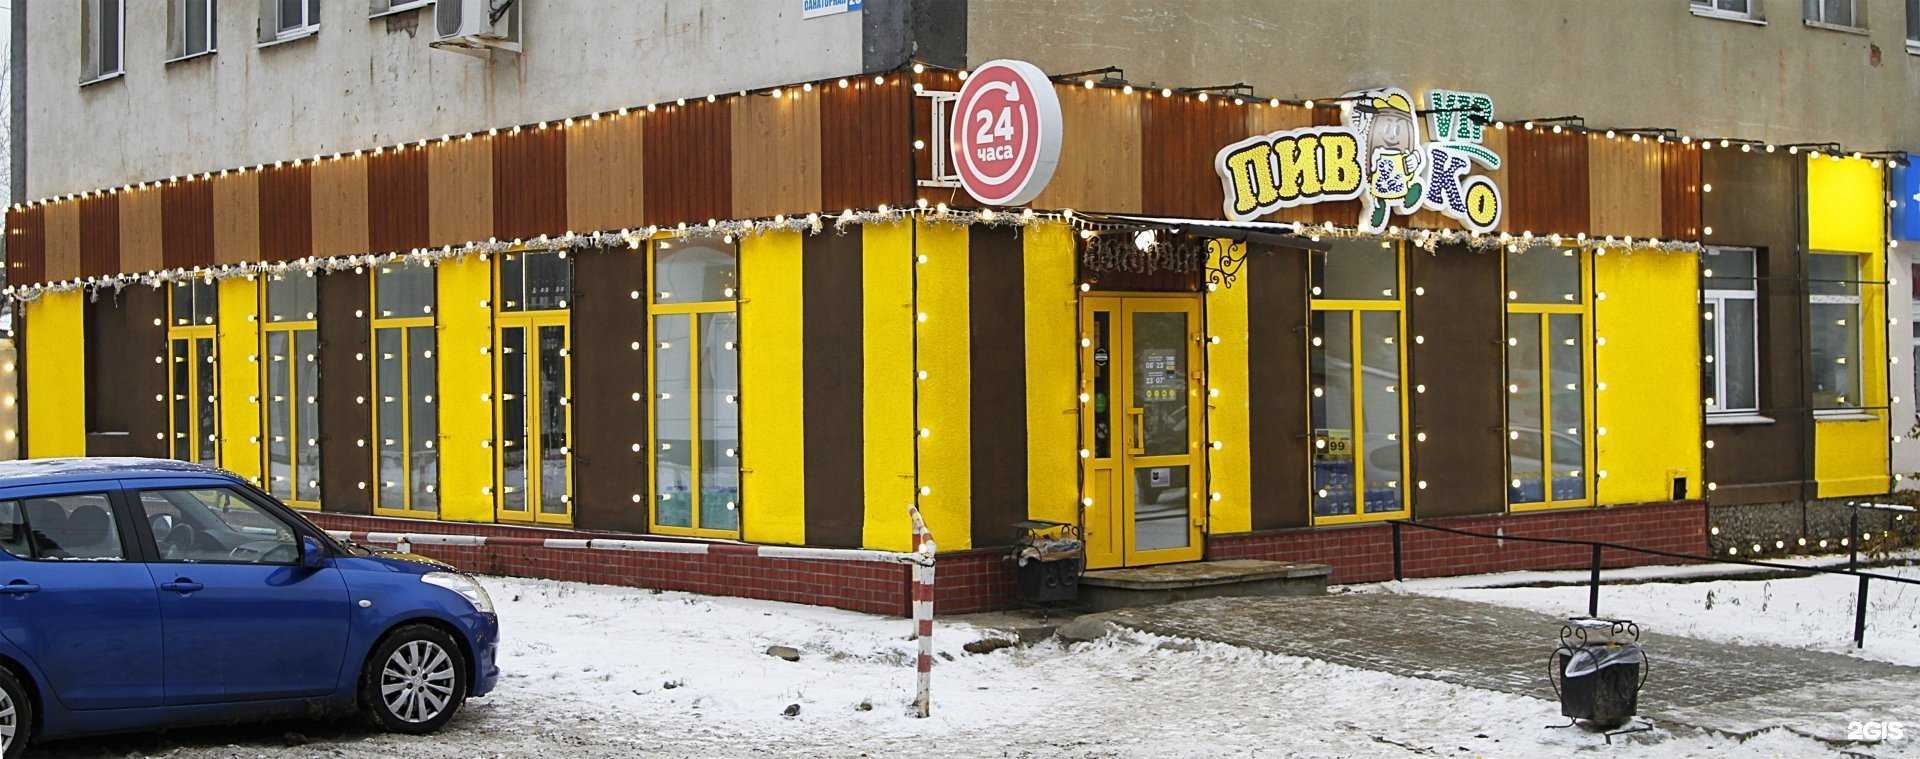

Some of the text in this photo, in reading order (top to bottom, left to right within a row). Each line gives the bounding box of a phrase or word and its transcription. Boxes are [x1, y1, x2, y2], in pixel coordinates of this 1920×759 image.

[976, 106, 1014, 144] 24
[977, 144, 1014, 162] часа
[1226, 133, 1362, 215] ПИВ
